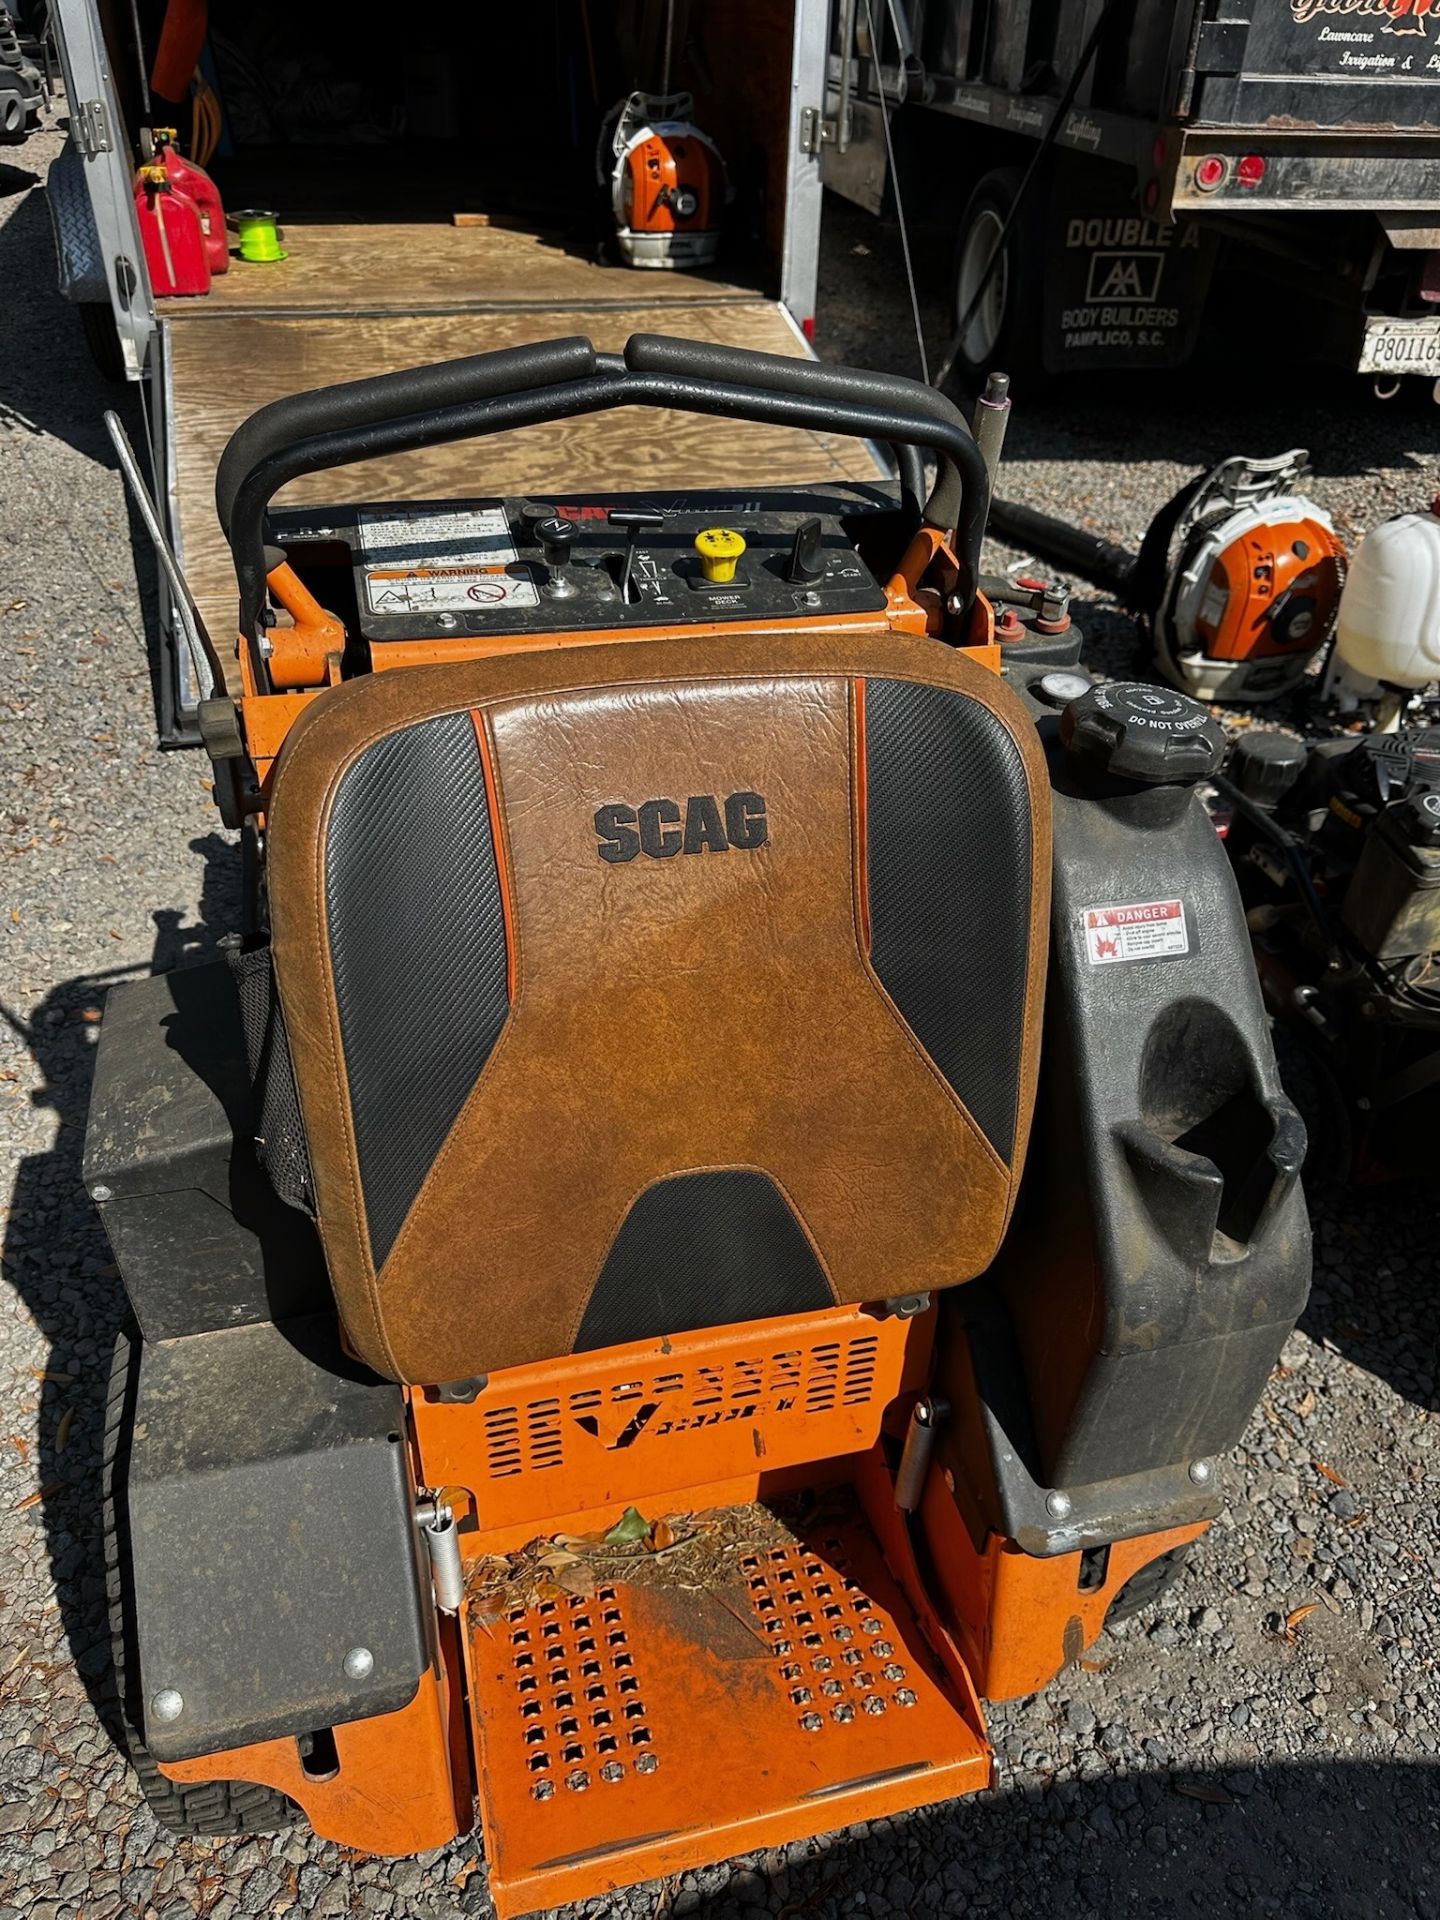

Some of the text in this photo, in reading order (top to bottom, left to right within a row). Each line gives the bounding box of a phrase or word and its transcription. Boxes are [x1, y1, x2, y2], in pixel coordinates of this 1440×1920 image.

[1318, 26, 1374, 43] Lawncare
[1339, 51, 1395, 70] Irrigation
[1401, 55, 1414, 70] &
[1066, 217, 1201, 249] DOUBLE A
[1061, 305, 1180, 329] BODY BUILDERS
[1064, 330, 1166, 349] PAMPLICO, S.C.
[428, 567, 489, 577] WARNING
[1128, 713, 1208, 731] DO NOT OVERFILL
[594, 791, 769, 864] SCAG
[1116, 907, 1168, 923] DANGER
